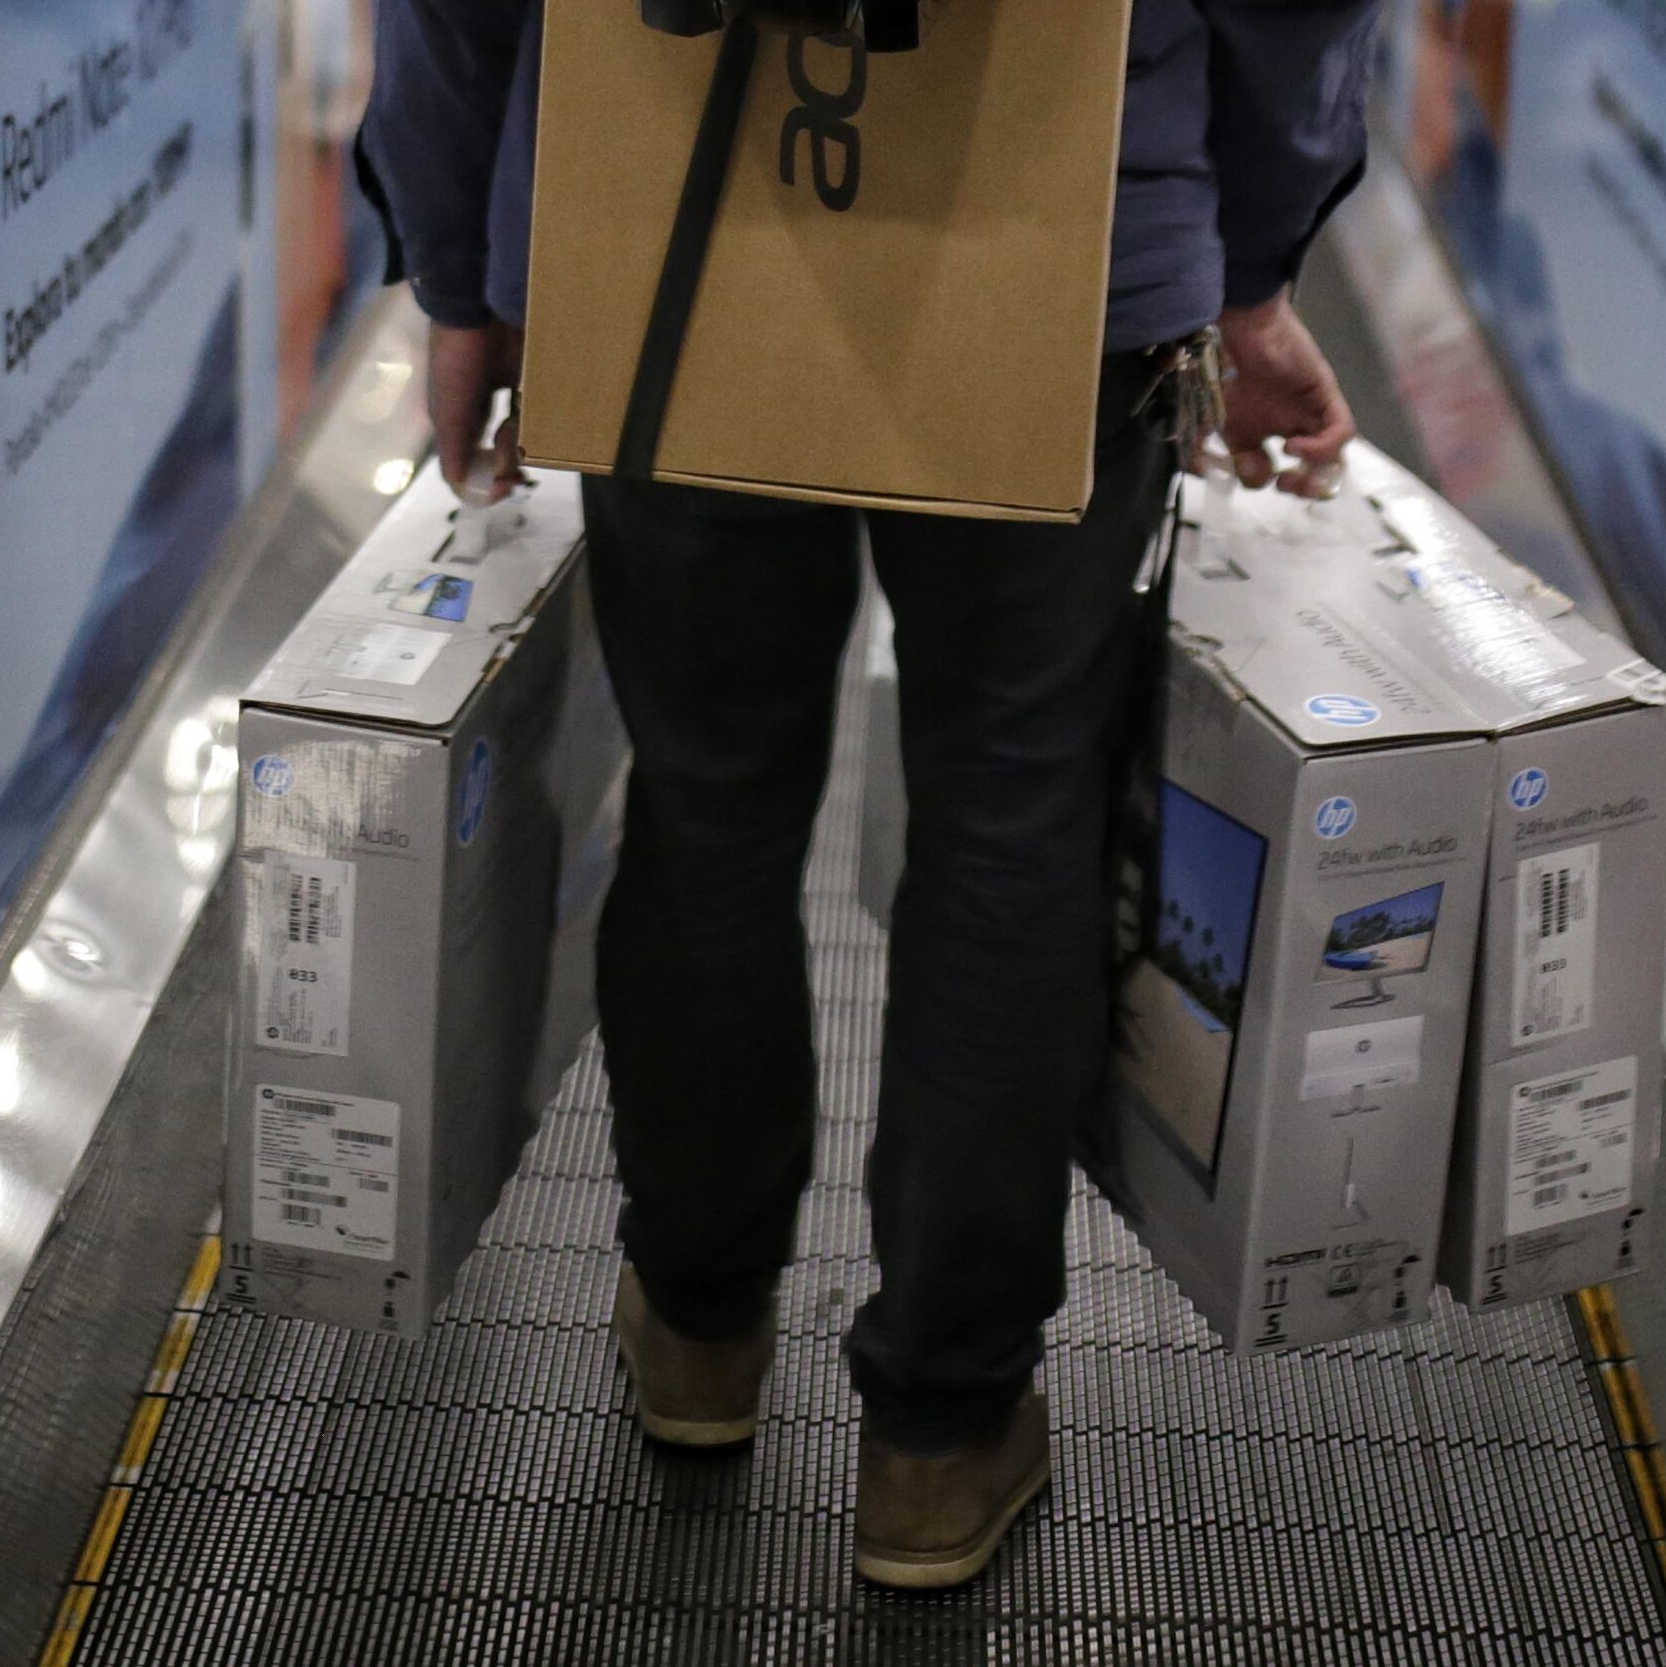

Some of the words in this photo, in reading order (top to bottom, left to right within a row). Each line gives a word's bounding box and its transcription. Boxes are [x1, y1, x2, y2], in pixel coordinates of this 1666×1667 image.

[779, 30, 868, 212] ac
[1511, 768, 1548, 810] hp
[1318, 796, 1357, 838] hp
